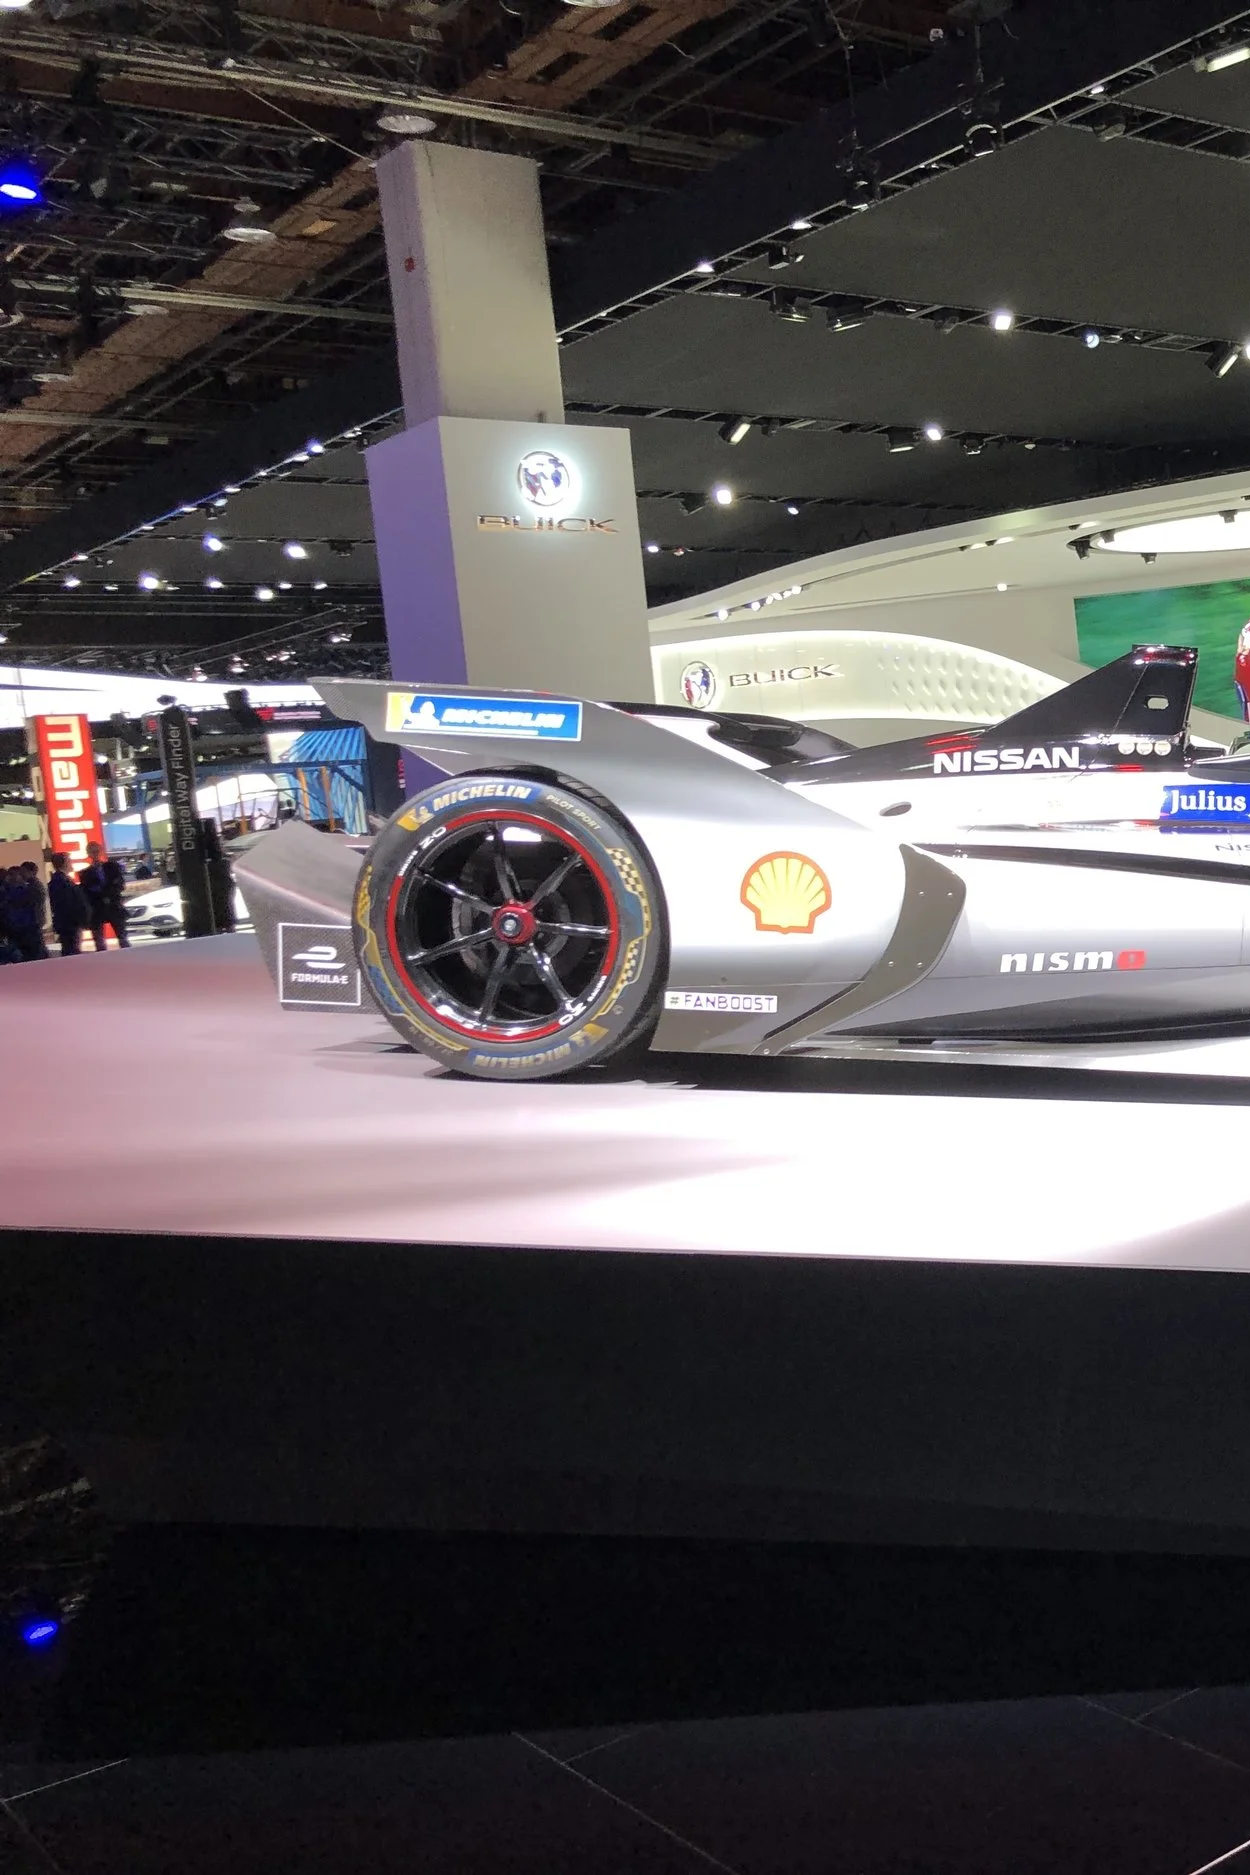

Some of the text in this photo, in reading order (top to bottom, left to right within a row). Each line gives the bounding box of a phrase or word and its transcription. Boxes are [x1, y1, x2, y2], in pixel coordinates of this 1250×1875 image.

[478, 515, 620, 532] BUICK
[729, 664, 838, 687] BUICK
[933, 747, 1080, 774] NISSAN
[166, 724, 196, 852] Digital Way Finder
[433, 784, 532, 811] MICHELIN
[546, 794, 602, 831] PILOT SPORT
[1170, 790, 1247, 814] Julius
[474, 1043, 572, 1068] MICHELIN
